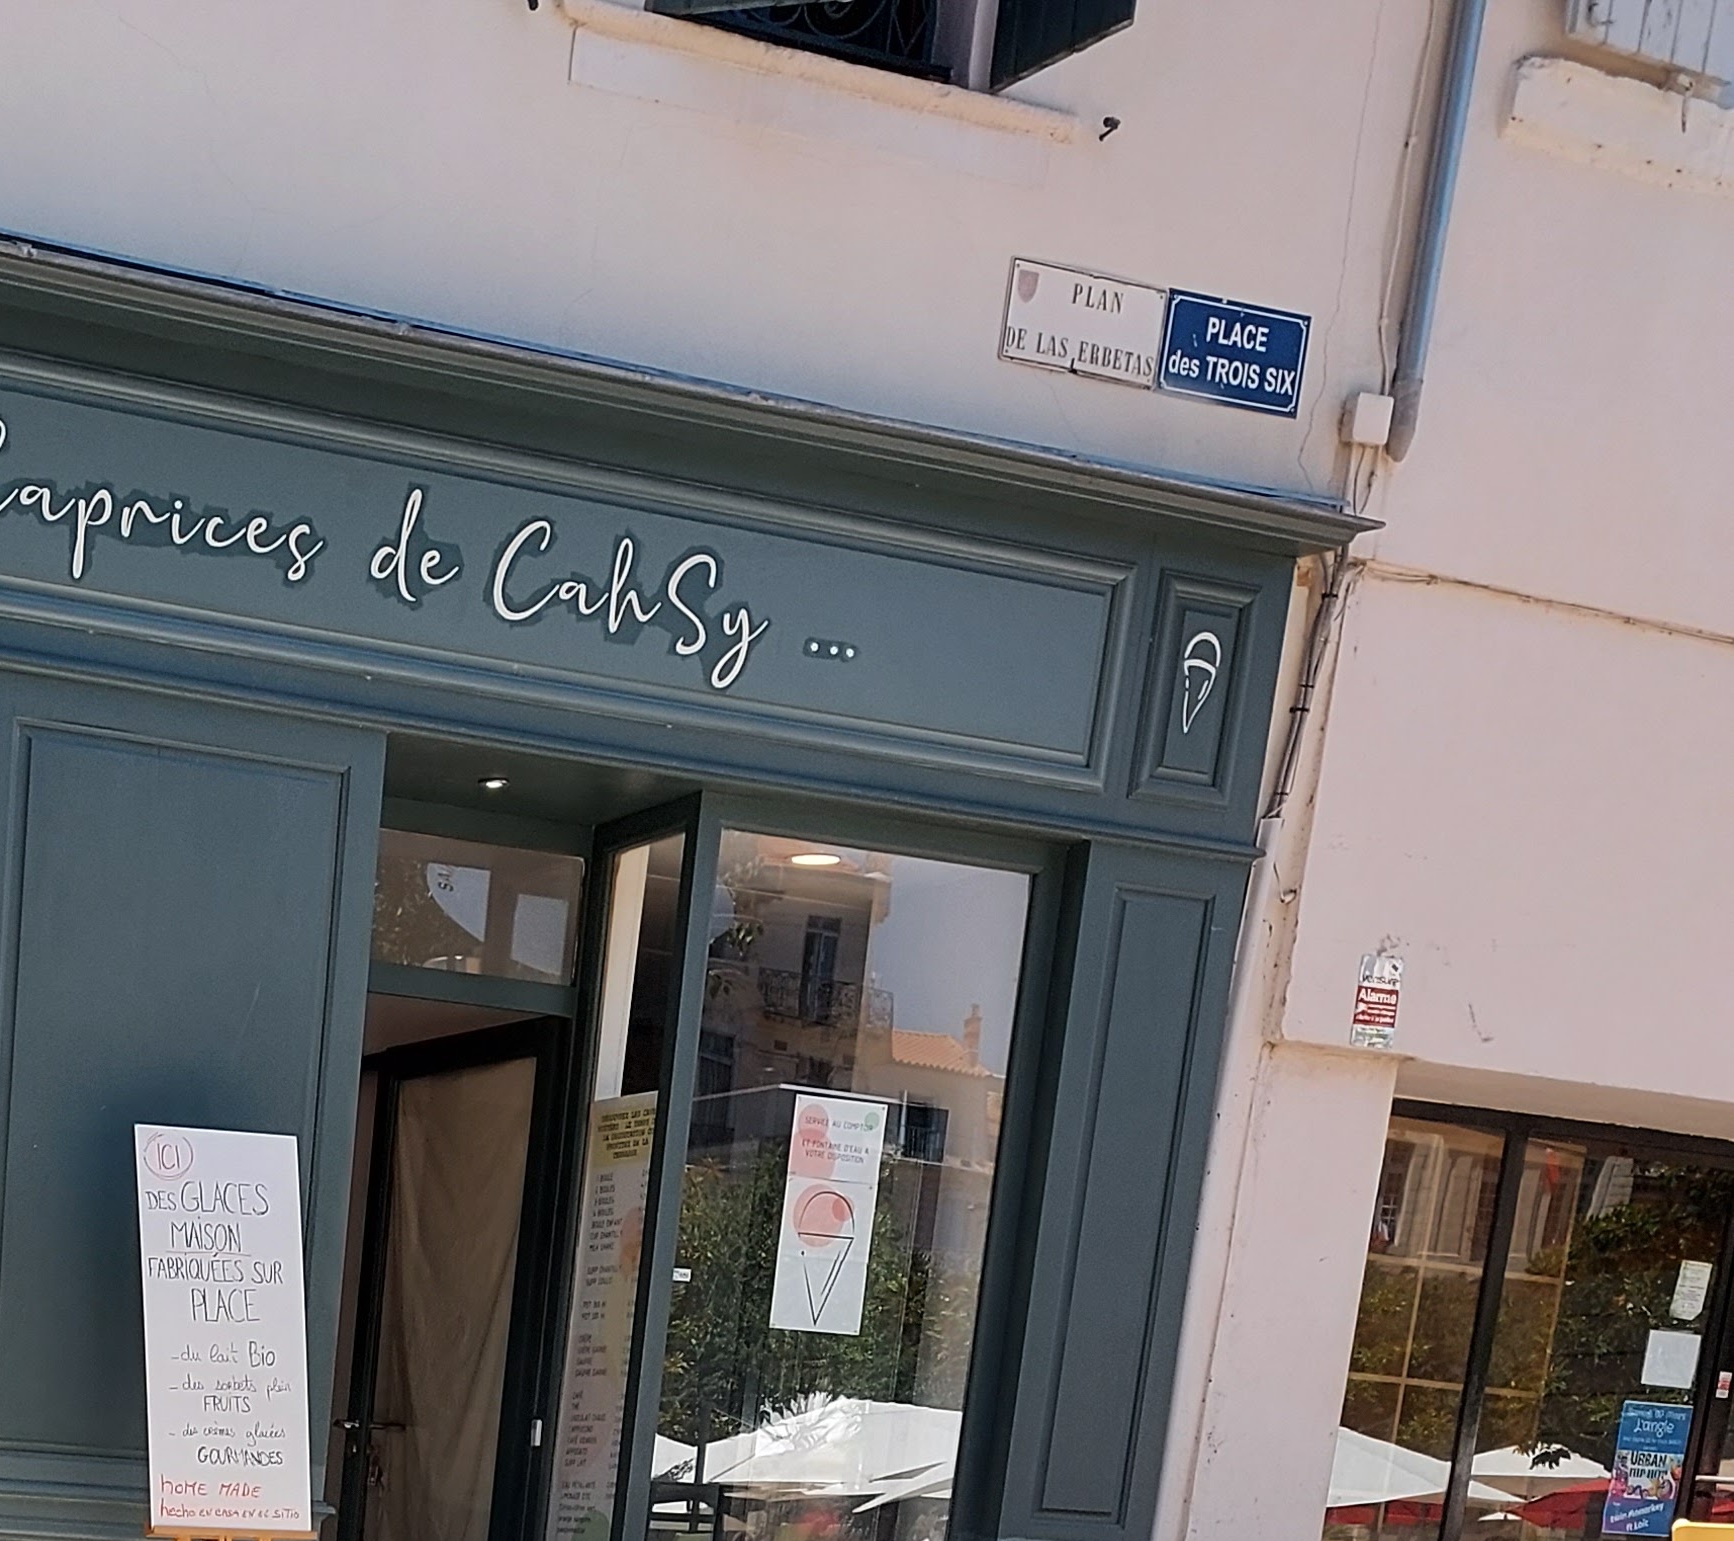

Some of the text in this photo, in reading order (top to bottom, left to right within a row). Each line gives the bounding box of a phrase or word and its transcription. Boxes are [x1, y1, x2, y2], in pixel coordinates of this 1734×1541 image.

[1072, 283, 1124, 314] PLAN
[1206, 317, 1269, 351] PLACE
[1006, 325, 1154, 377] DE LAS ERBETAS
[1168, 350, 1297, 396] des TROIS SIX
[369, 486, 460, 602] de
[490, 519, 770, 690] CahSy
[156, 1143, 180, 1170] ICI
[145, 1180, 269, 1216] DES GLACES
[251, 1260, 283, 1285] SUR
[191, 1287, 260, 1323] PLACE
[209, 1342, 238, 1364] lait
[248, 1340, 276, 1368] Bio
[215, 1374, 257, 1393] sorbets
[203, 1394, 251, 1413] FRUITS
[197, 1446, 283, 1467] GOURMANDES
[1630, 1451, 1668, 1467] URBAN
[218, 1483, 261, 1498] MADE
